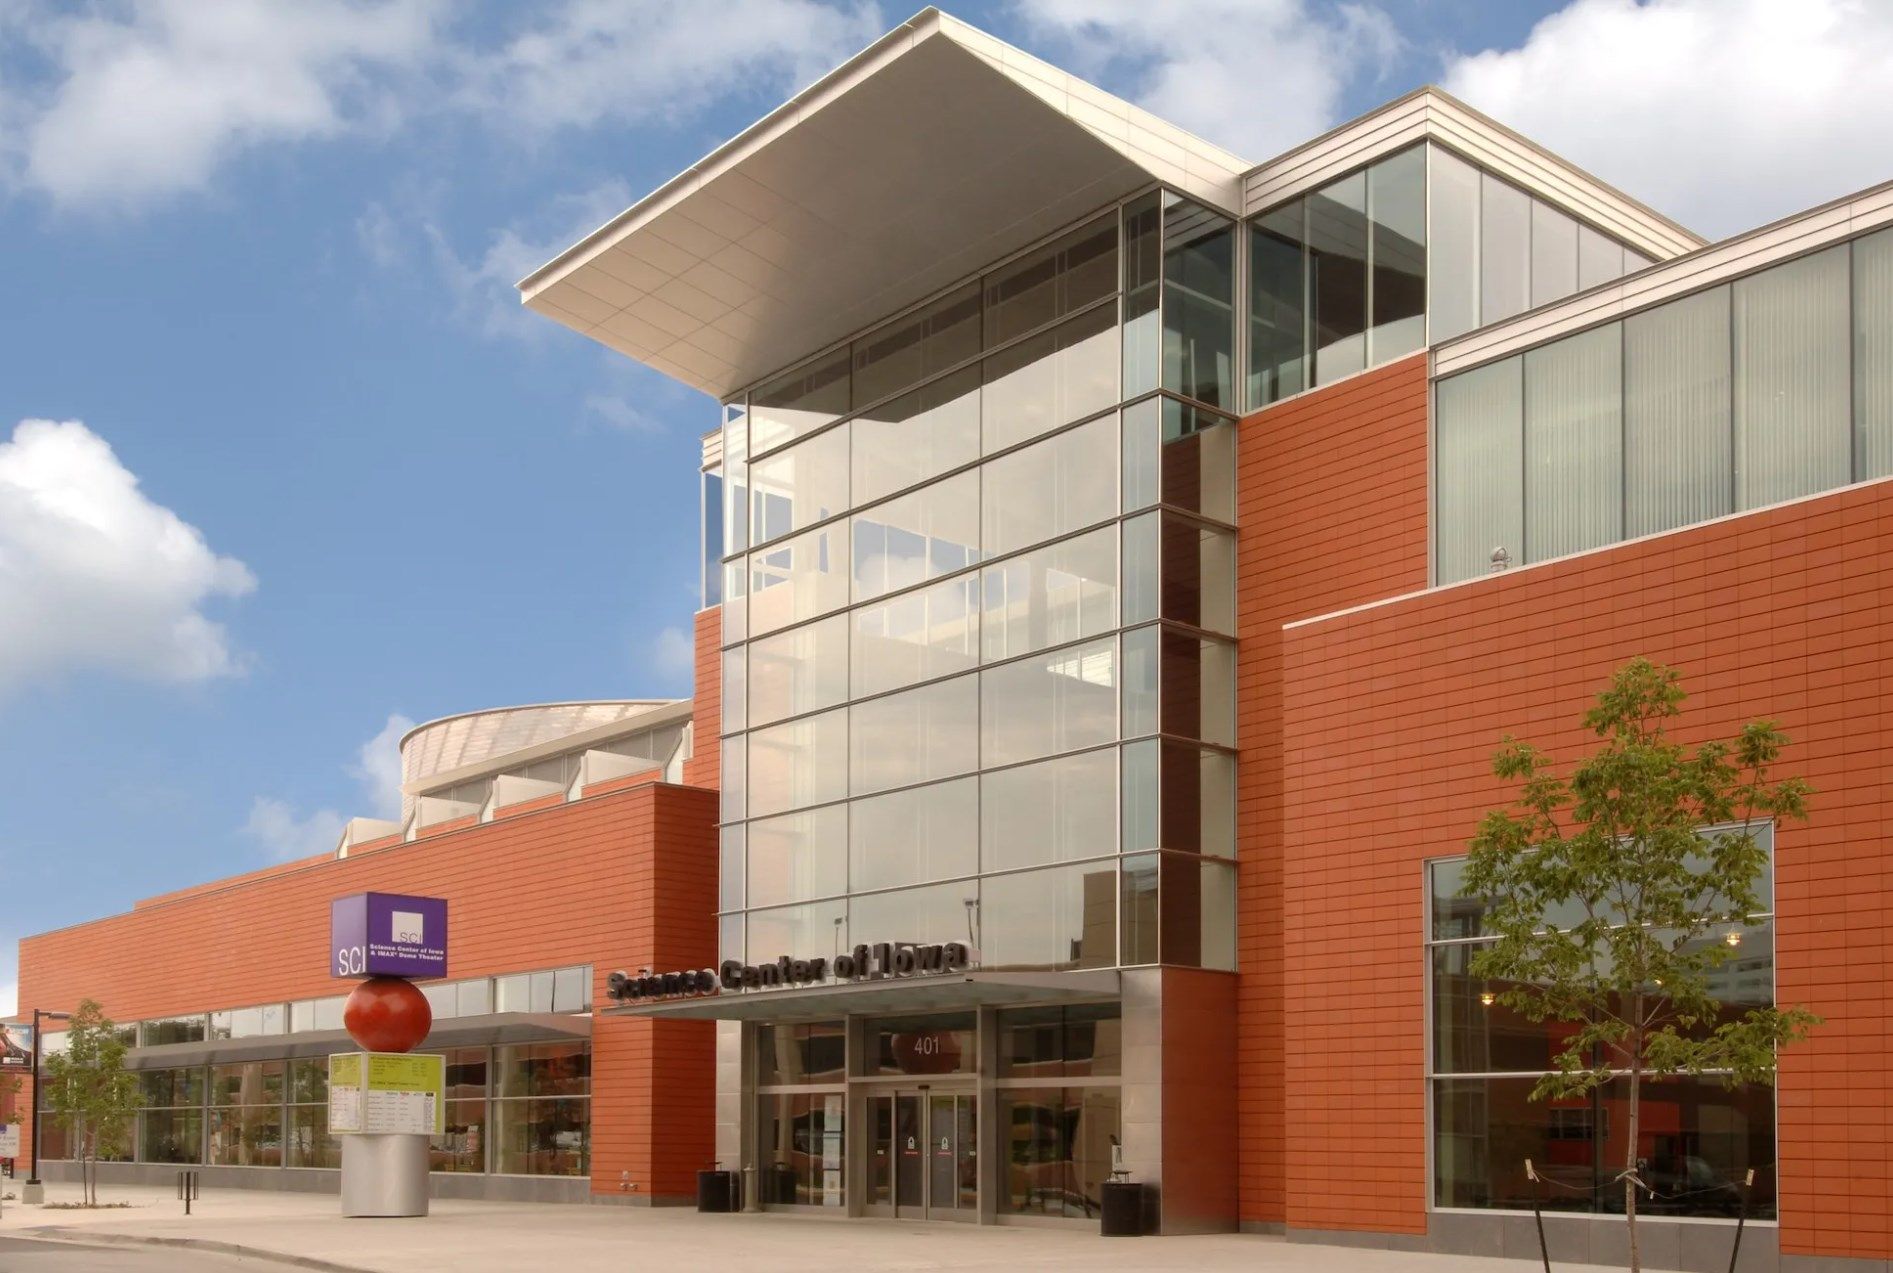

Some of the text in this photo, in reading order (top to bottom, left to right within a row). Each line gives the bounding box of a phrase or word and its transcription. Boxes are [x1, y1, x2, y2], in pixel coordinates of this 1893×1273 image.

[400, 932, 423, 944] SCI
[369, 943, 396, 951] Science
[338, 946, 366, 976] SCI
[418, 953, 444, 961] Theater
[607, 942, 969, 1000] Science Center of Iowa
[914, 1036, 940, 1055] 401
